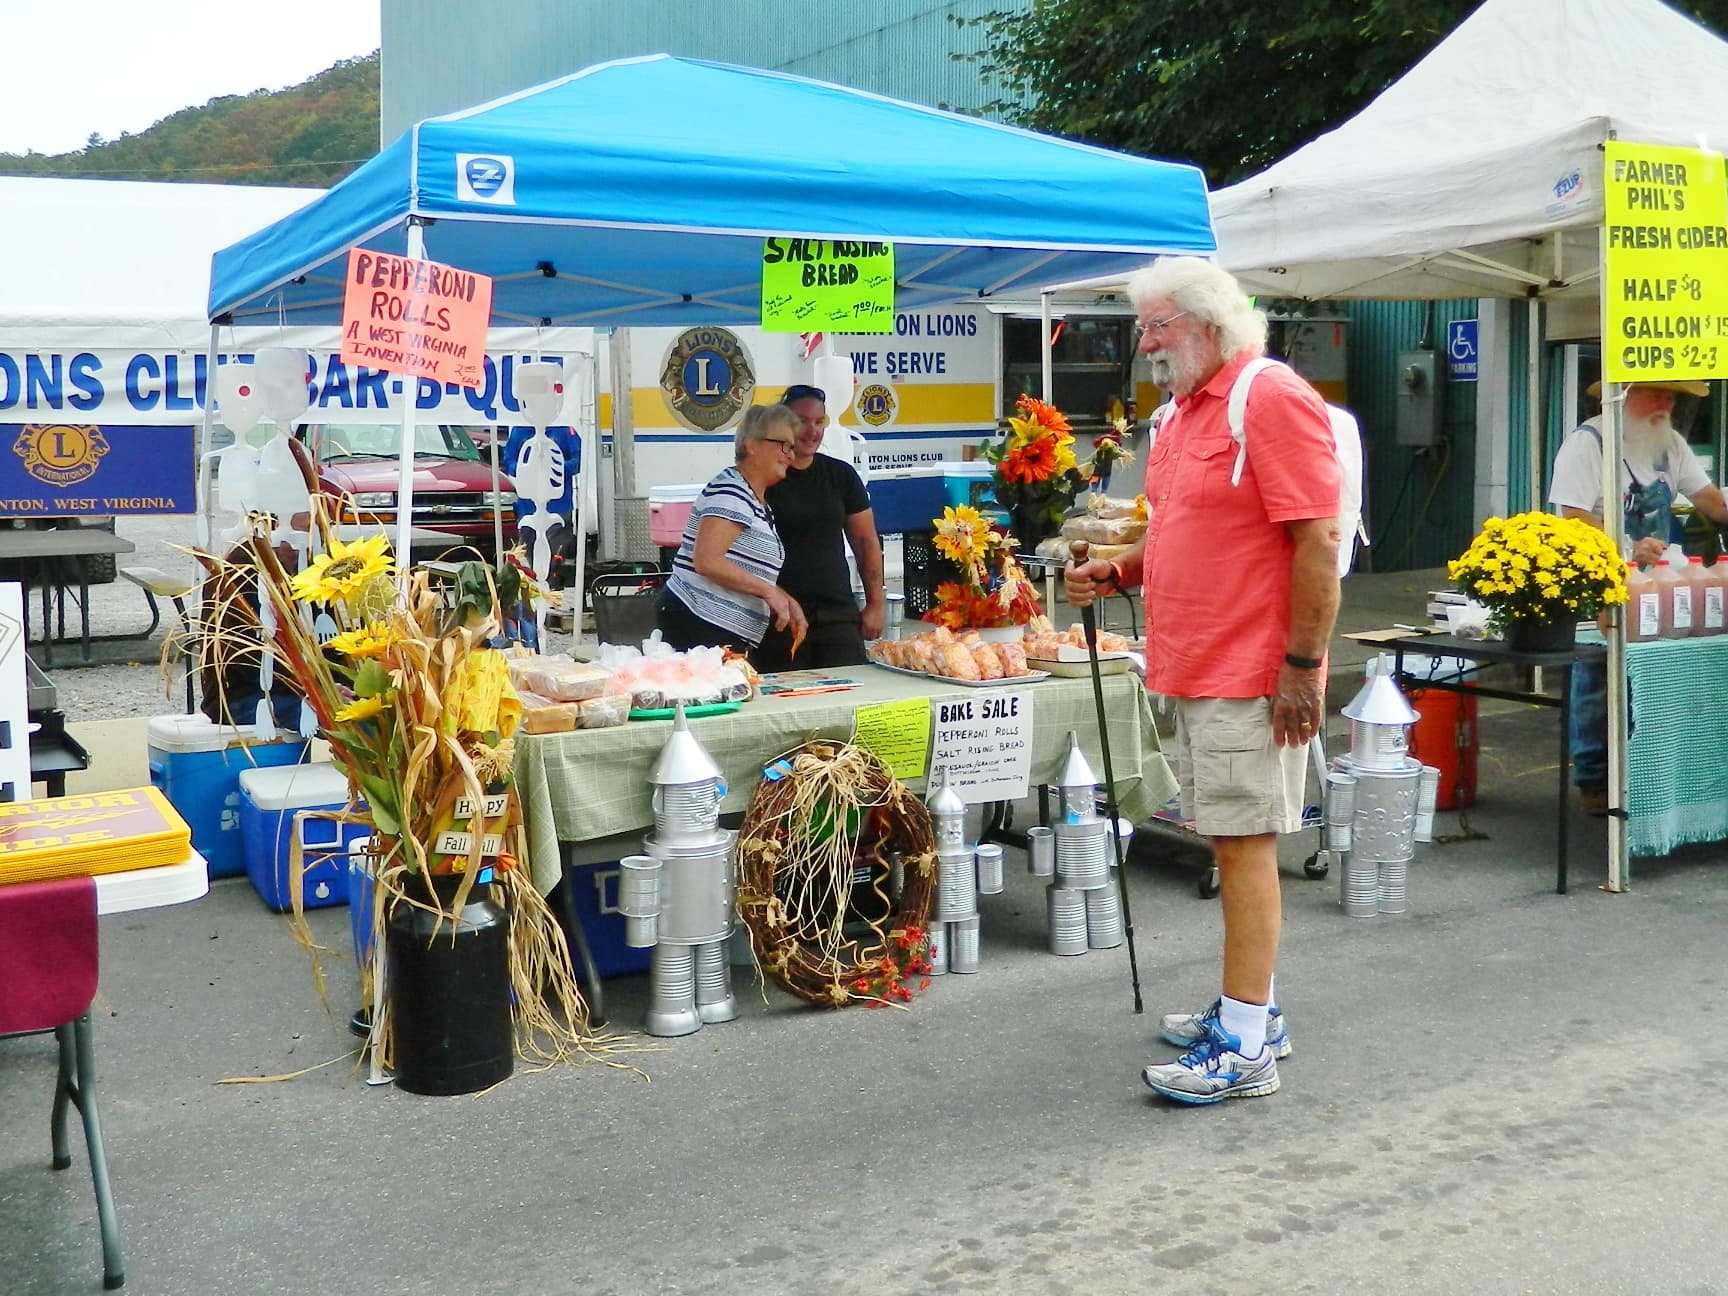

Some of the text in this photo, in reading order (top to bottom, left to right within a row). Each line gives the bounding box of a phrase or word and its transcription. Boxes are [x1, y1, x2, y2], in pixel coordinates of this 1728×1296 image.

[1615, 159, 1688, 187] FARMER
[1627, 187, 1685, 211] PHIL'S
[1609, 225, 1728, 249] FRESH CIDER
[356, 253, 476, 303] PEPPERONI
[802, 263, 859, 287] BREAD
[1623, 273, 1702, 301] HALF $8
[370, 291, 451, 332] ROLLS
[926, 314, 977, 336] LIONS
[1622, 316, 1701, 339] GALLON
[347, 320, 468, 361] A WEST VIRGINIA
[350, 342, 440, 373] INVENTION
[851, 351, 946, 374] WE SERVE
[1622, 346, 1675, 369] CUPS
[126, 353, 255, 411] CLU
[695, 358, 720, 395] L
[872, 397, 883, 412] L
[53, 432, 76, 459] L
[892, 452, 918, 463] LIONS
[921, 451, 943, 461] CLUB
[35, 466, 90, 482] INTERNATIONAL
[55, 498, 98, 510] WEST
[103, 496, 175, 509] VIRGINIA
[940, 696, 1019, 723] BAKE SALE
[937, 726, 1019, 744] PEPPERONI ROLLS
[935, 740, 1025, 760] SALT RISING BREAD
[444, 836, 467, 850] Fall
